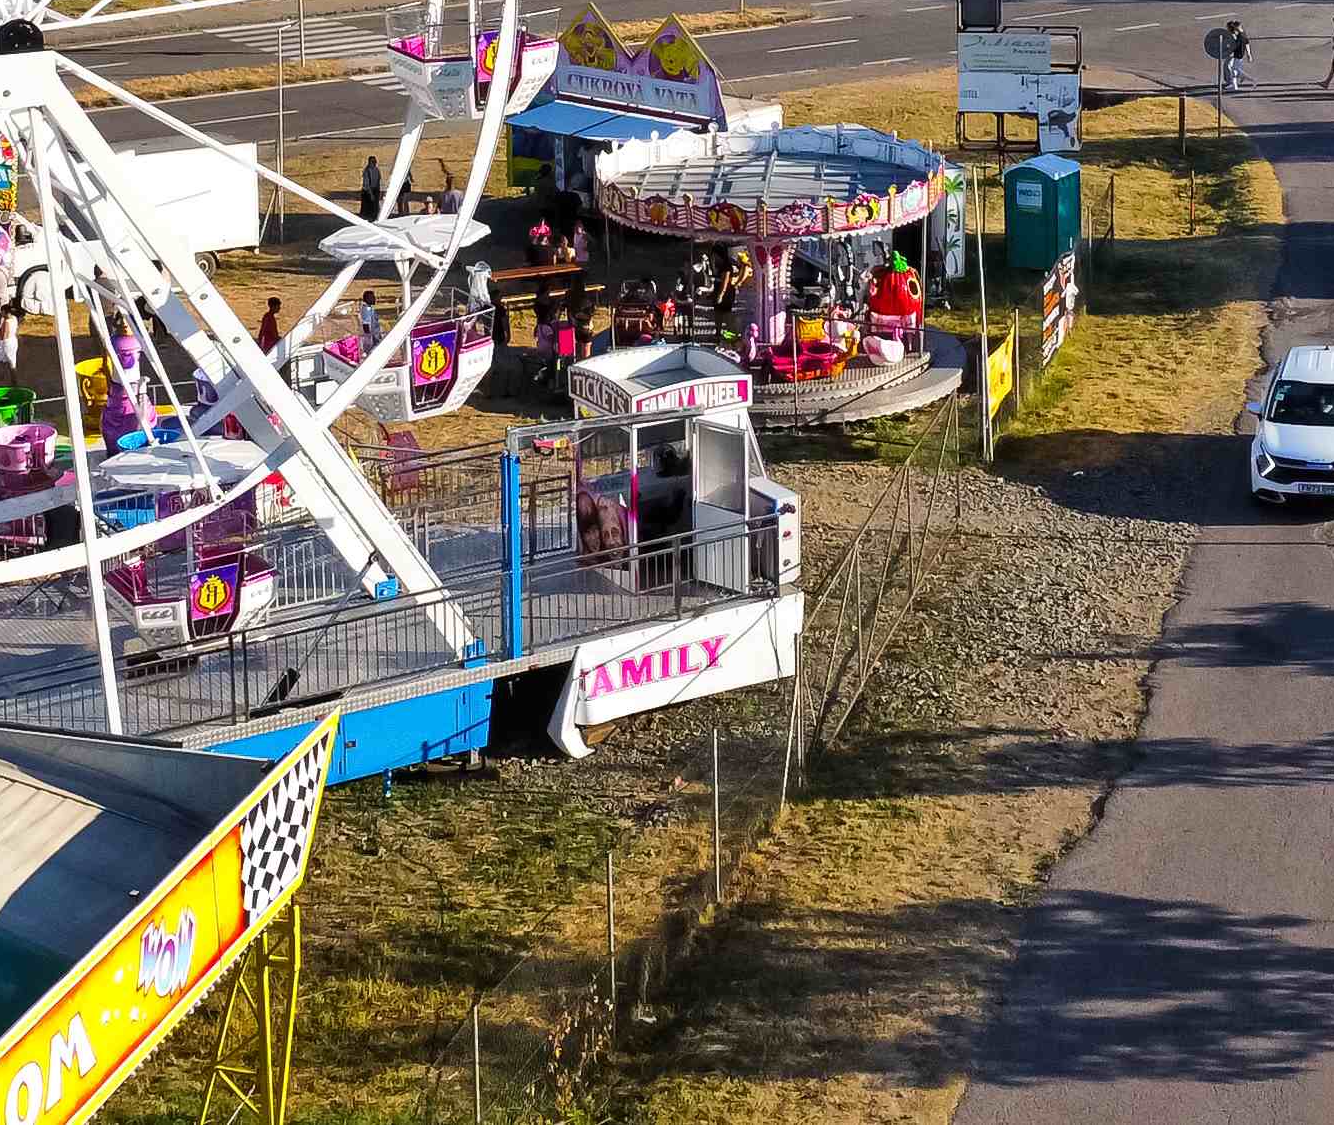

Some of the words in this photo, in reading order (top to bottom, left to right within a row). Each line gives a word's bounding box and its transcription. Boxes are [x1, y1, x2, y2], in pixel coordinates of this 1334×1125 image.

[573, 375, 626, 414] TICKETS
[640, 385, 692, 412] FAMILY
[693, 381, 744, 407] WHEEL
[580, 635, 728, 700] AMILY
[137, 906, 197, 998] WOW
